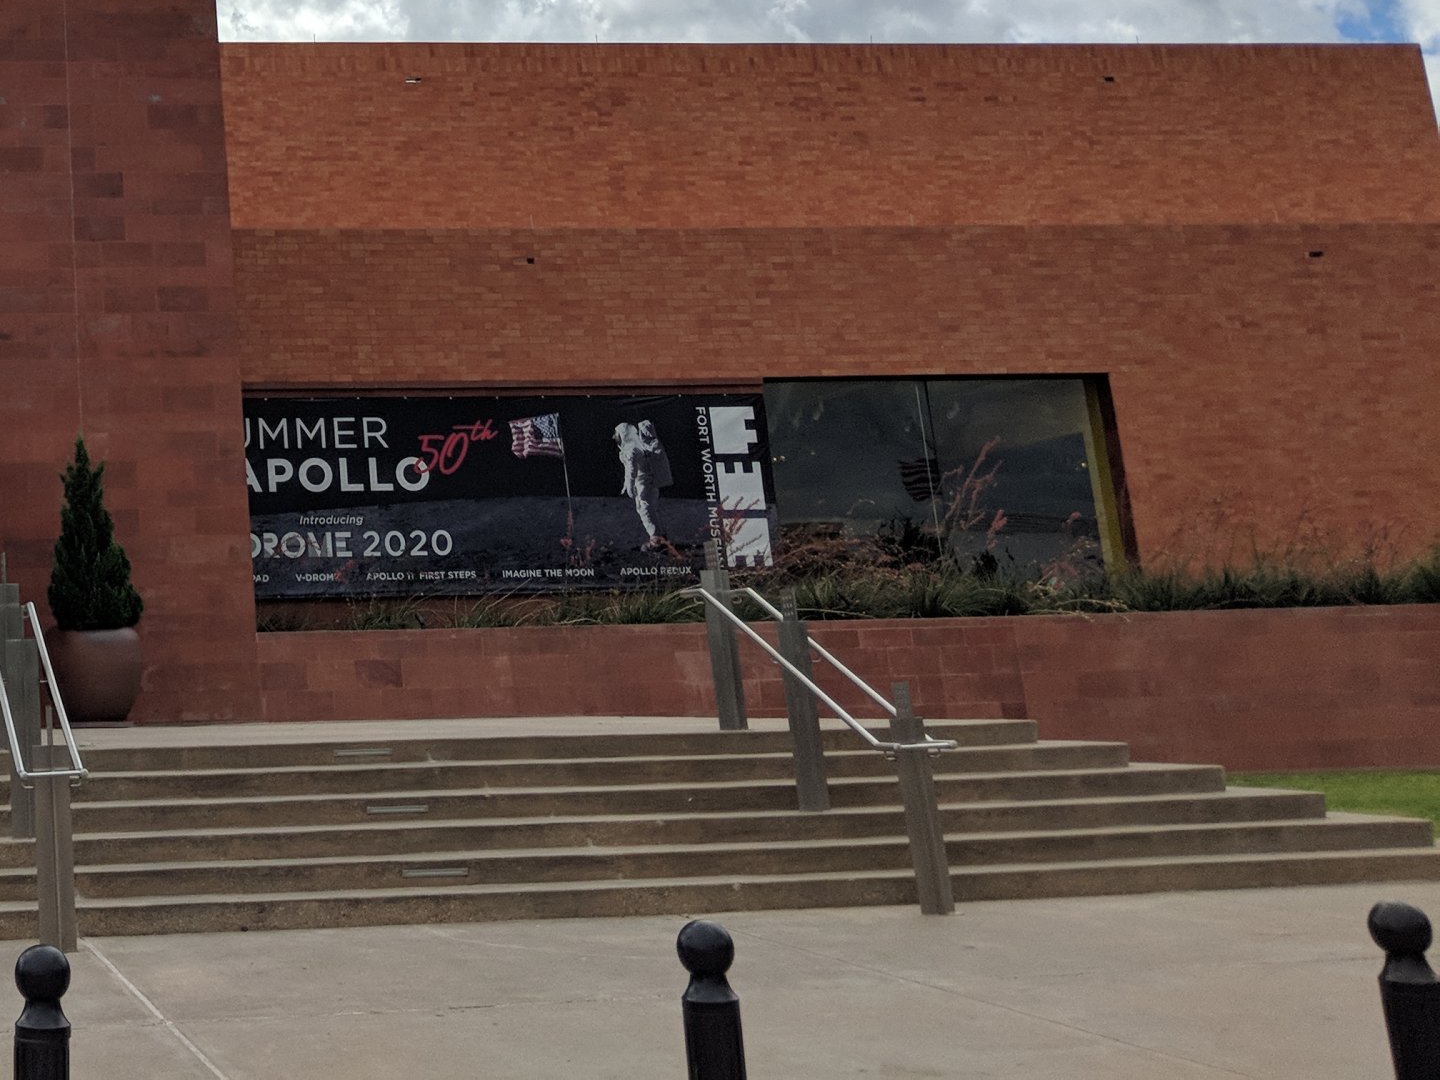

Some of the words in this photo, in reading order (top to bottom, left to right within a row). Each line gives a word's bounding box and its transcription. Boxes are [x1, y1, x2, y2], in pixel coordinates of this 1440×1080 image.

[695, 406, 710, 445] FORT
[414, 419, 499, 475] 50th
[700, 448, 717, 502] WORTH
[299, 515, 364, 526] Introducing
[363, 529, 453, 558] 2020
[366, 572, 405, 580] APOLLO
[419, 571, 446, 580] FIRST
[447, 570, 477, 579] STEPS
[502, 569, 542, 578] IMAGINE
[544, 569, 563, 578] THE
[565, 568, 595, 577] MOON
[620, 567, 657, 576] APOLLO
[659, 566, 692, 575] REDUX
[295, 573, 334, 582] V-DROM
